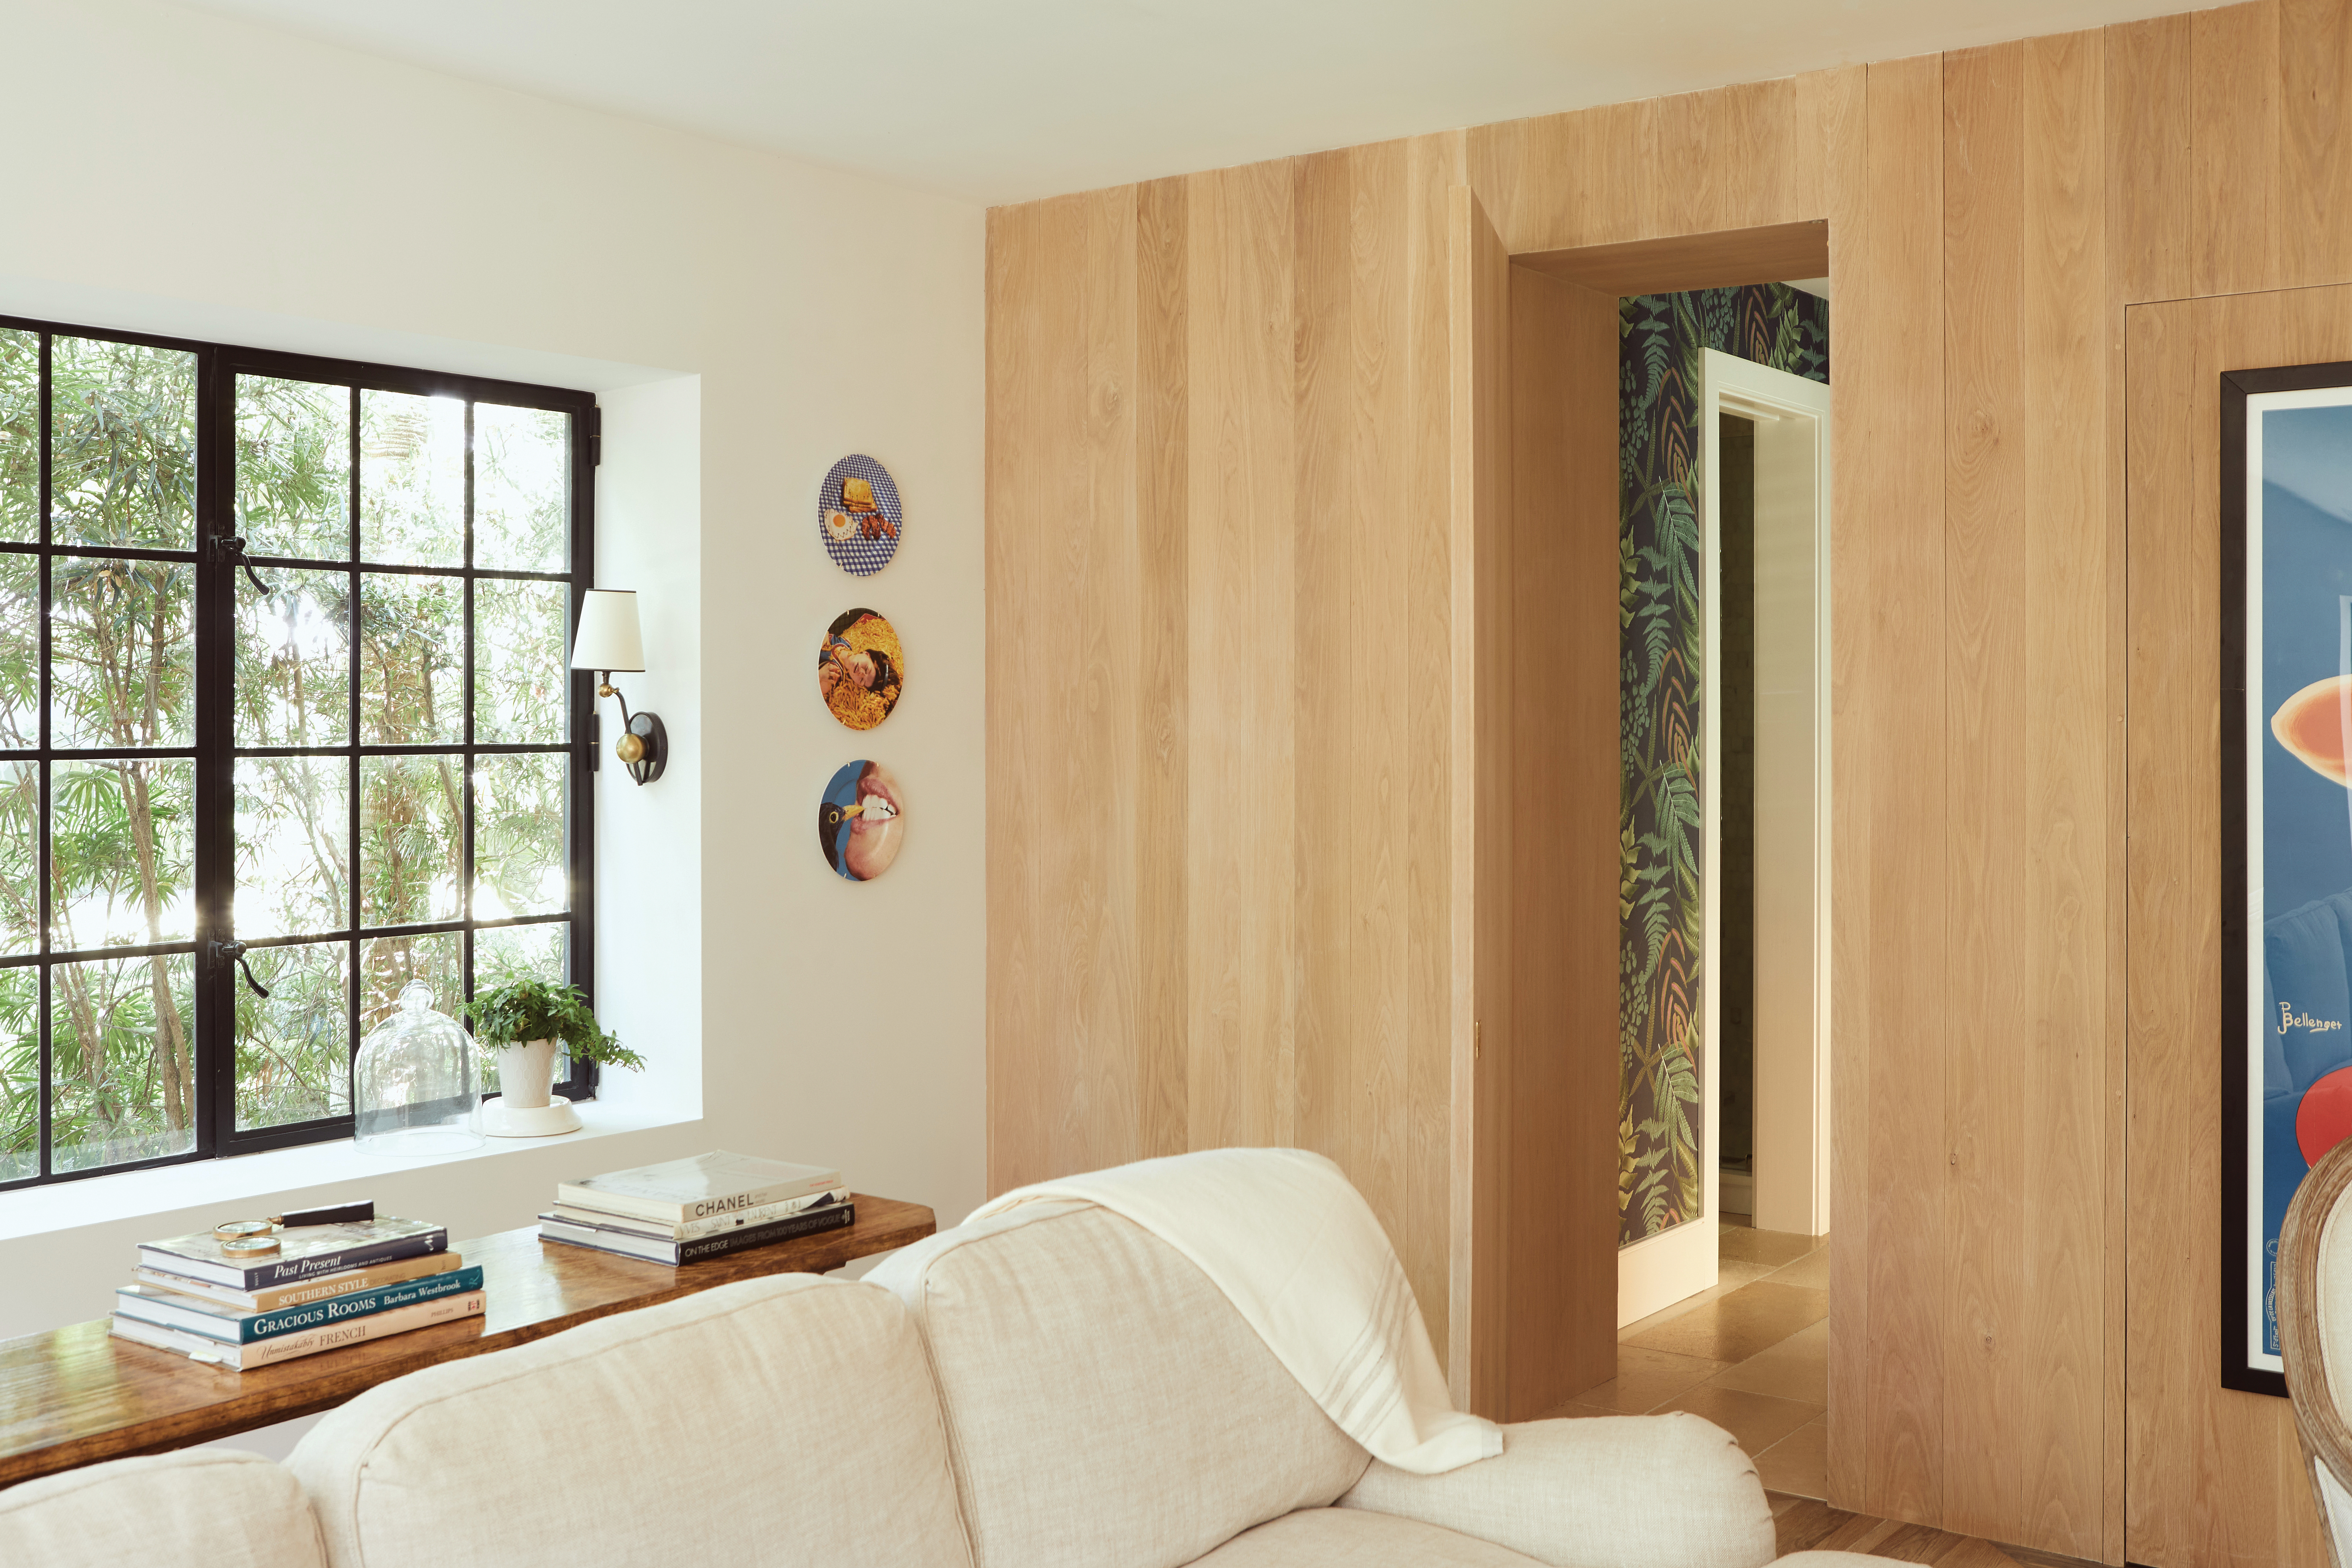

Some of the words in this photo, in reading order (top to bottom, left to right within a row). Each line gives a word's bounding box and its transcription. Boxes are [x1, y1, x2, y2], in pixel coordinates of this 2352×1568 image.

[679, 1222, 700, 1237] YVES
[710, 1214, 731, 1229] SAINT
[747, 1204, 777, 1220] LAURENT
[695, 1194, 754, 1216] CHANEL
[685, 1247, 698, 1257] ON
[698, 1244, 710, 1255] THE
[711, 1239, 729, 1252] EDGE
[729, 1233, 756, 1248] IMAGES
[757, 1228, 776, 1241] FROM
[777, 1226, 787, 1237] 100
[787, 1222, 808, 1234] YEARS
[808, 1219, 818, 1230] OF
[816, 1213, 841, 1227] VOGUE
[274, 1264, 298, 1279] Past
[301, 1256, 341, 1273] Present
[299, 1271, 315, 1280] LIVING
[329, 1262, 357, 1273] HEIRLOOMS
[369, 1256, 392, 1264] ANTIQUES
[254, 1309, 324, 1335] GRACIOUS
[328, 1298, 376, 1318] ROOMS
[384, 1292, 417, 1305] Barbara
[418, 1279, 461, 1297] Westbrook
[279, 1285, 337, 1306] SOUTHERN
[338, 1277, 368, 1292] STYLE
[257, 1334, 317, 1360] Unmistakably
[320, 1326, 366, 1346] FRENCH
[431, 1308, 453, 1317] PHILLIPS
